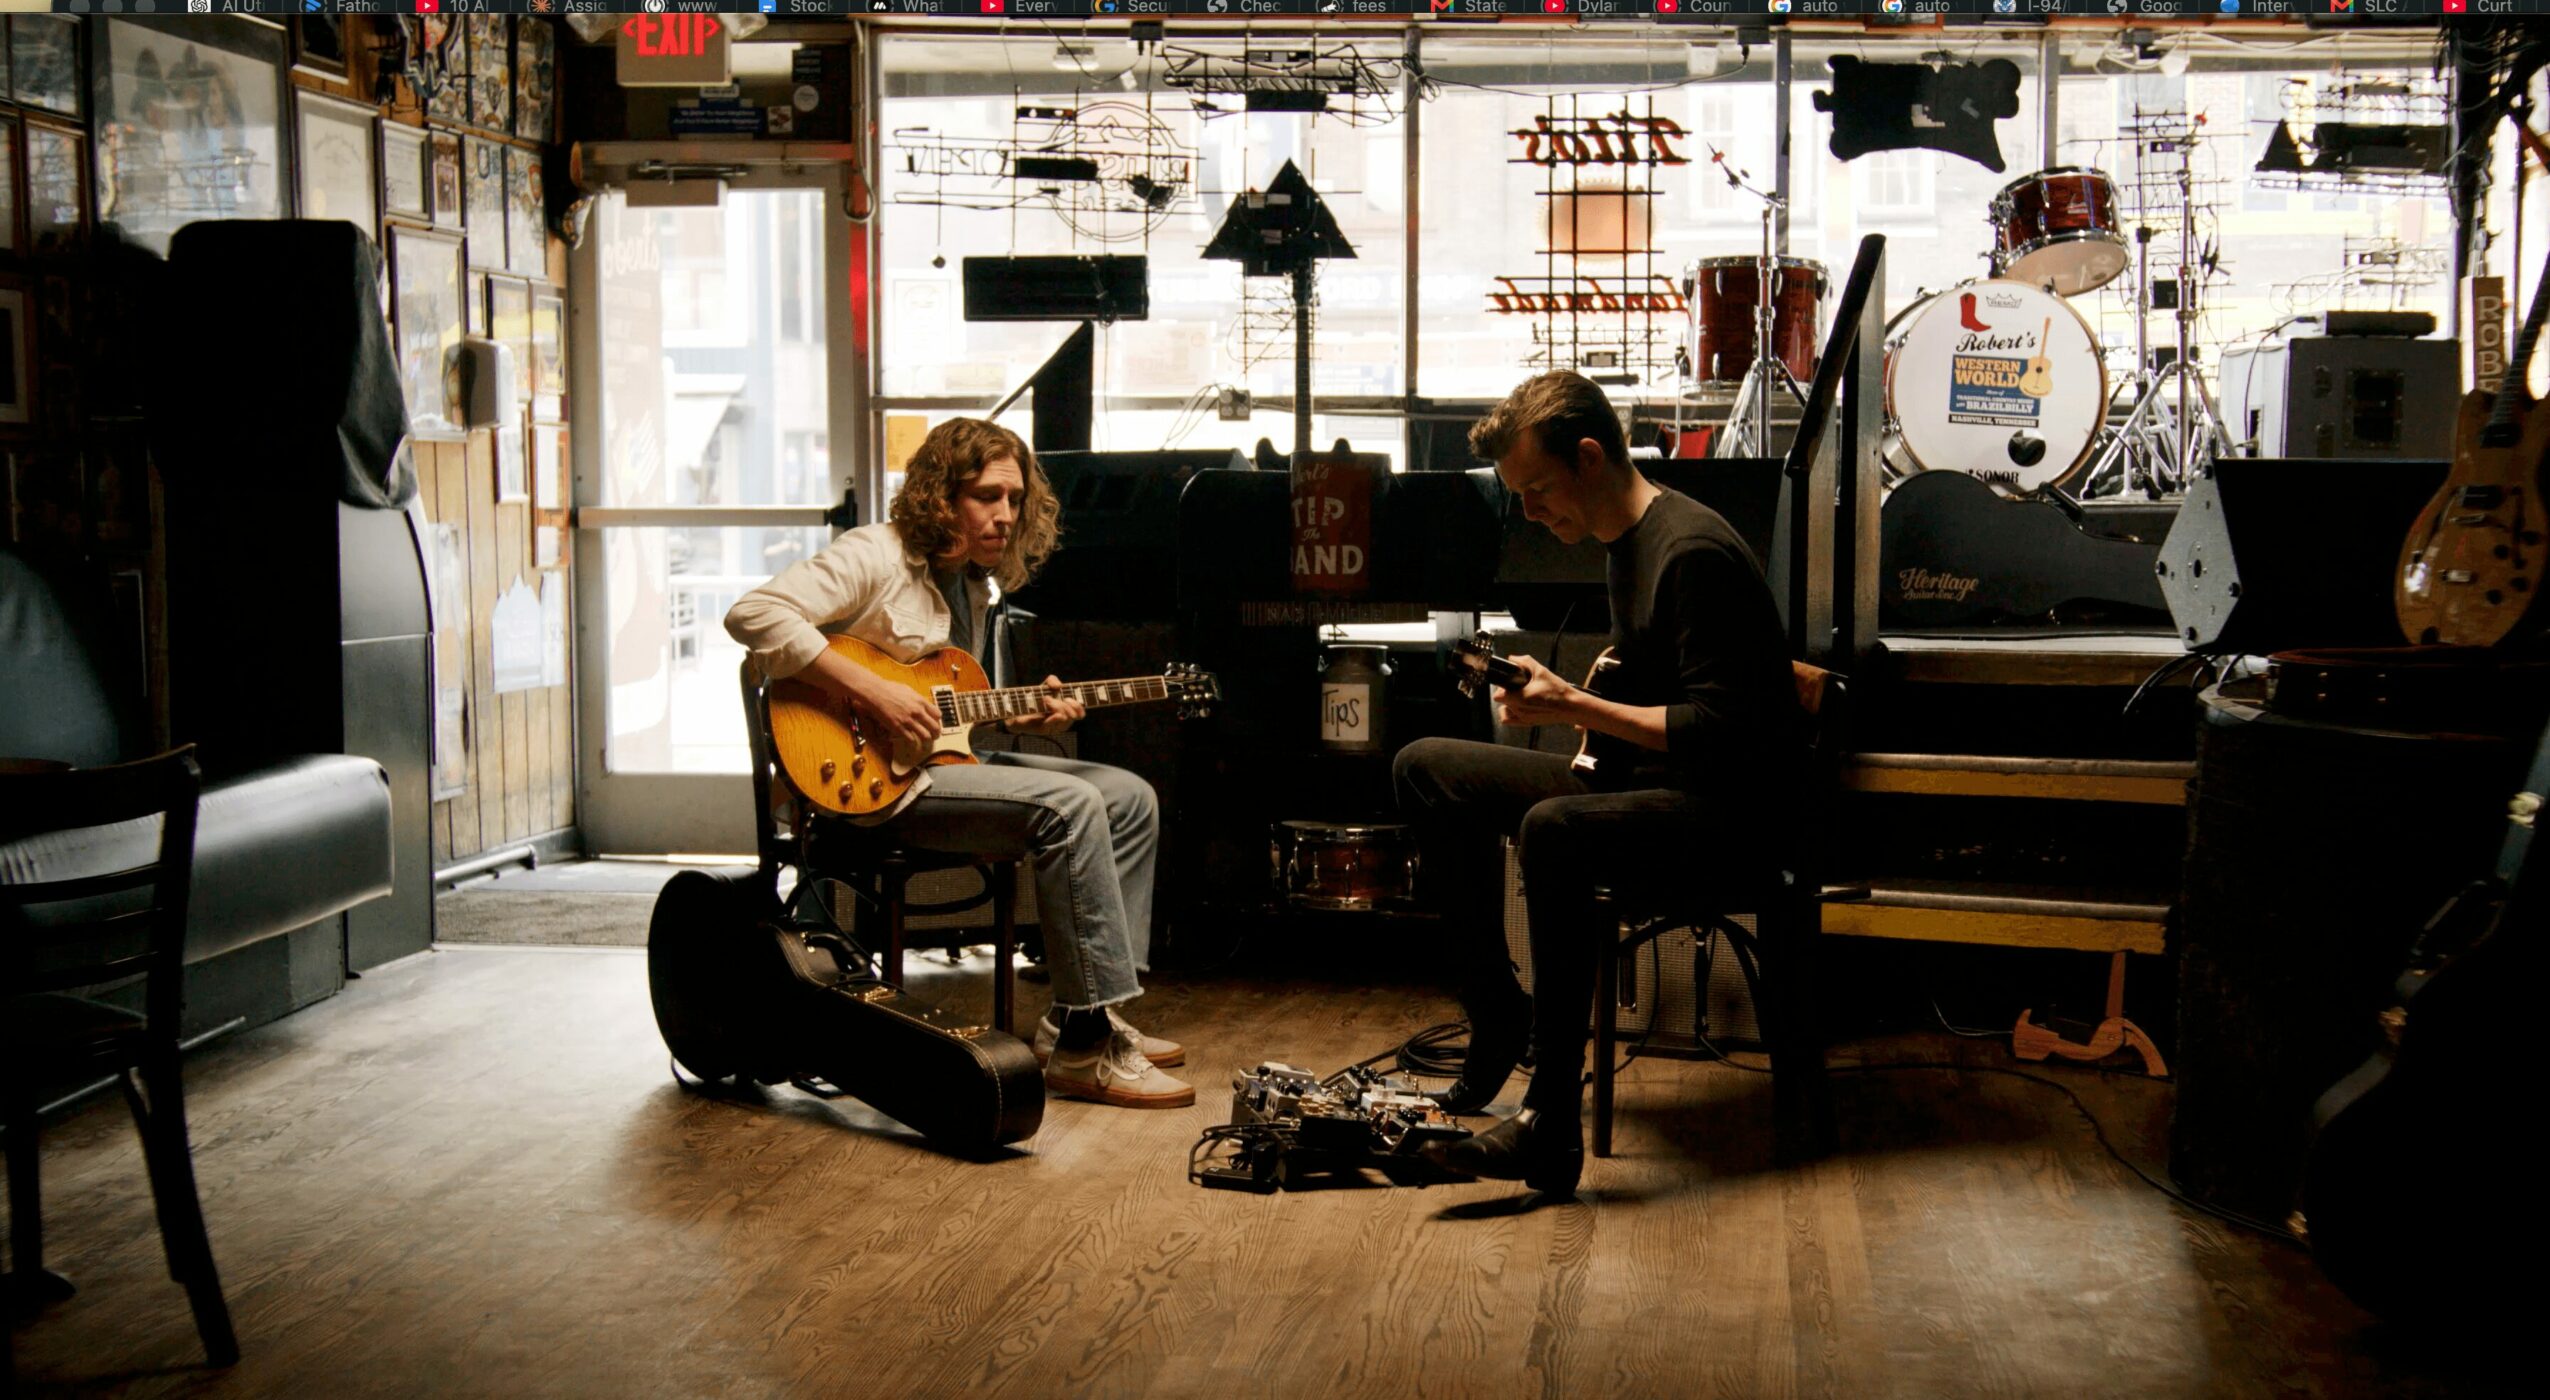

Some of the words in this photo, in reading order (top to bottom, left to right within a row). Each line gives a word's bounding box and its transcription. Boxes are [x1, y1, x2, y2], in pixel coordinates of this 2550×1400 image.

[635, 13, 706, 57] EXIT
[1956, 331, 2036, 352] Robert's
[1955, 357, 2021, 373] WESTERN
[1955, 370, 2020, 388] WORLD
[1966, 400, 2034, 414] BRAZILBILLY
[1976, 469, 2020, 484] SONOR
[1291, 495, 1345, 528] TIP
[1289, 545, 1364, 576] AND
[1899, 566, 1980, 602] Heritage
[1322, 689, 1360, 737] Tips
